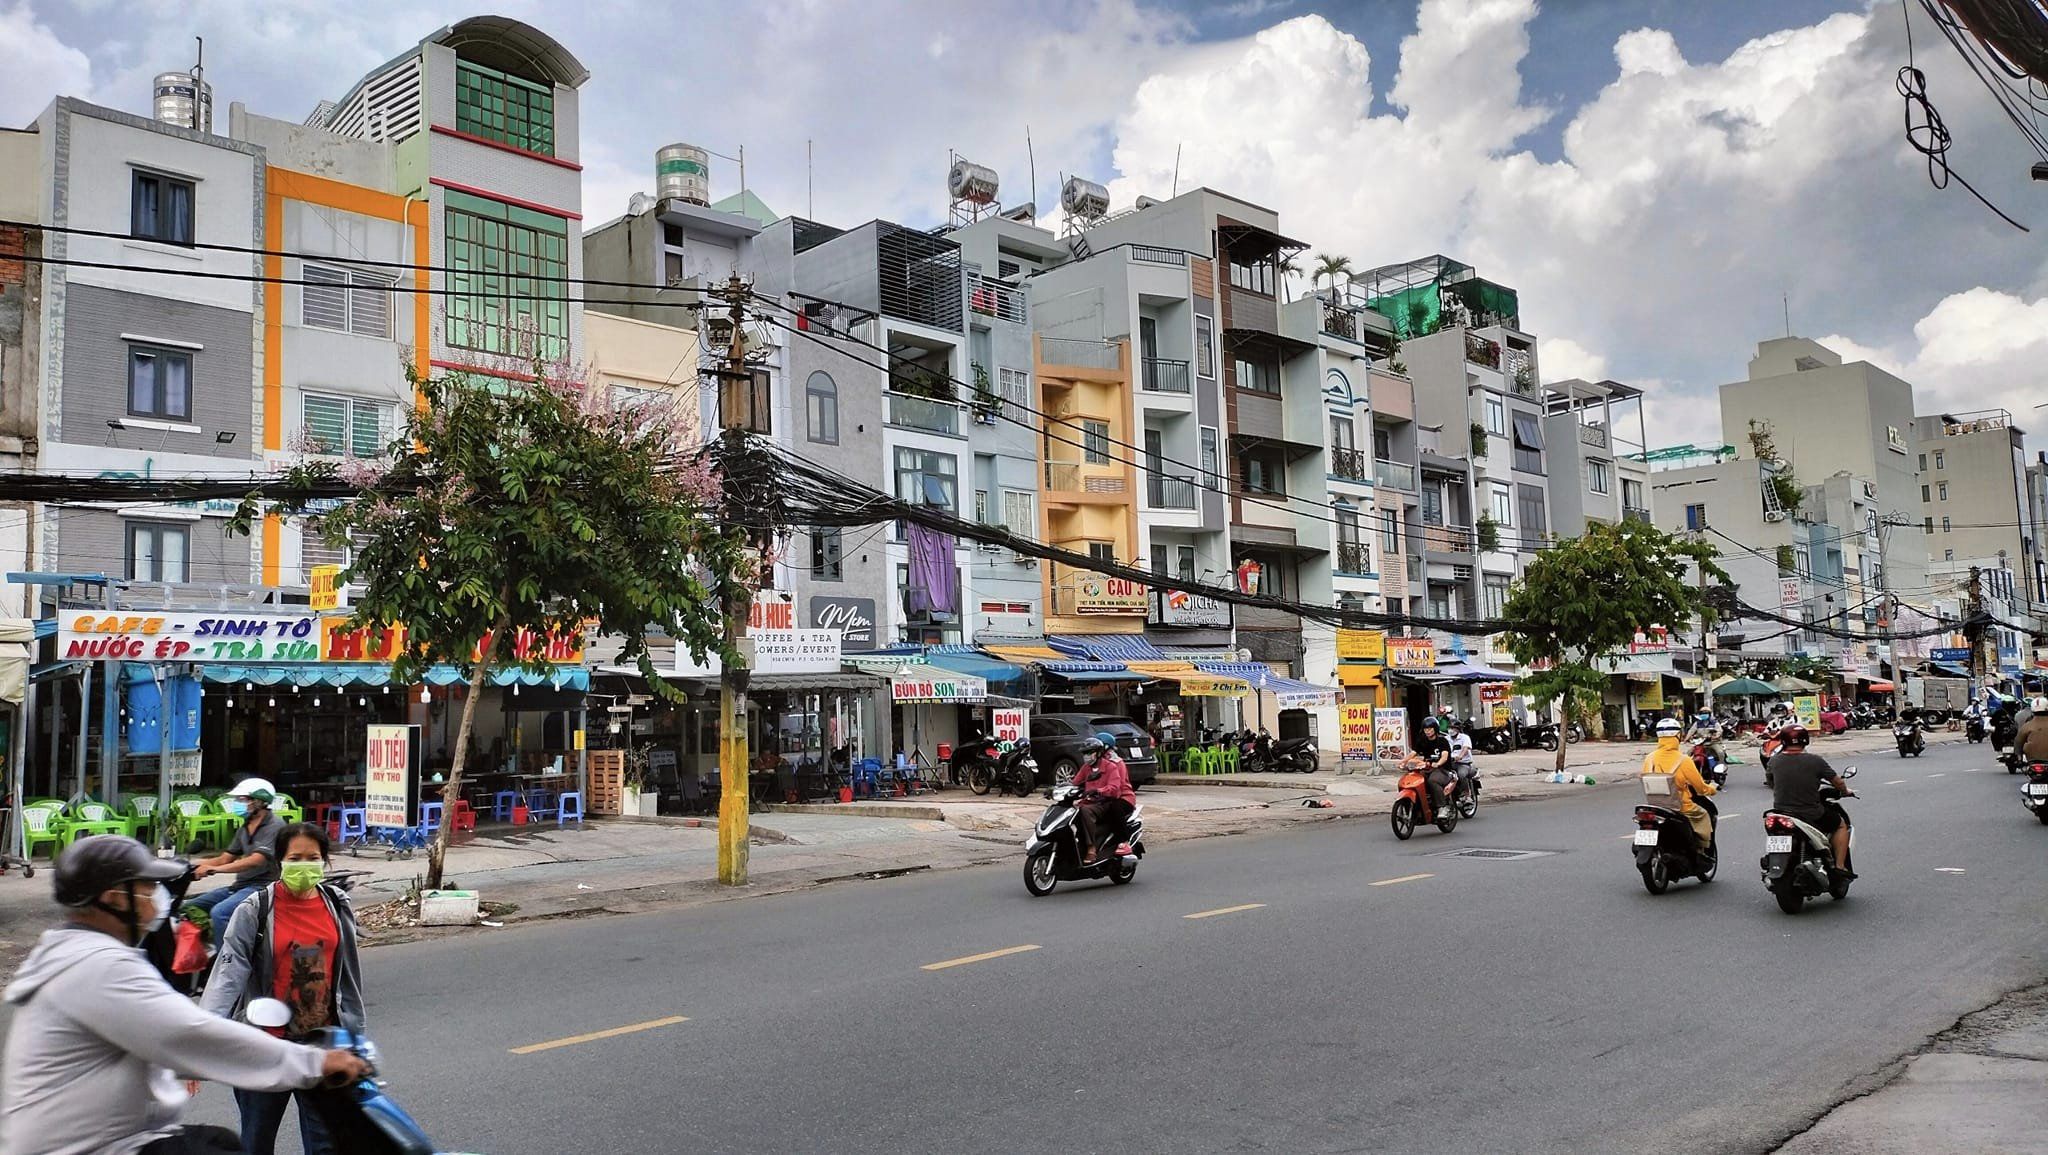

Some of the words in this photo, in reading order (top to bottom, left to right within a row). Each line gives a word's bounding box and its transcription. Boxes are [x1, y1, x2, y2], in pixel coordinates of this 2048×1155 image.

[1137, 583, 1144, 596] 3
[73, 615, 165, 634] CAFE
[194, 618, 268, 636] SINH
[812, 634, 832, 642] TEA
[66, 634, 145, 659] NƯỚC
[754, 645, 837, 655] OWERS/EVENT
[895, 681, 916, 697] BÚN
[934, 683, 955, 697] SON
[995, 712, 1021, 726] BÚN
[999, 727, 1017, 742] BÒ
[1342, 723, 1348, 735] 3
[1348, 723, 1370, 735] NGON
[386, 772, 401, 782] THO
